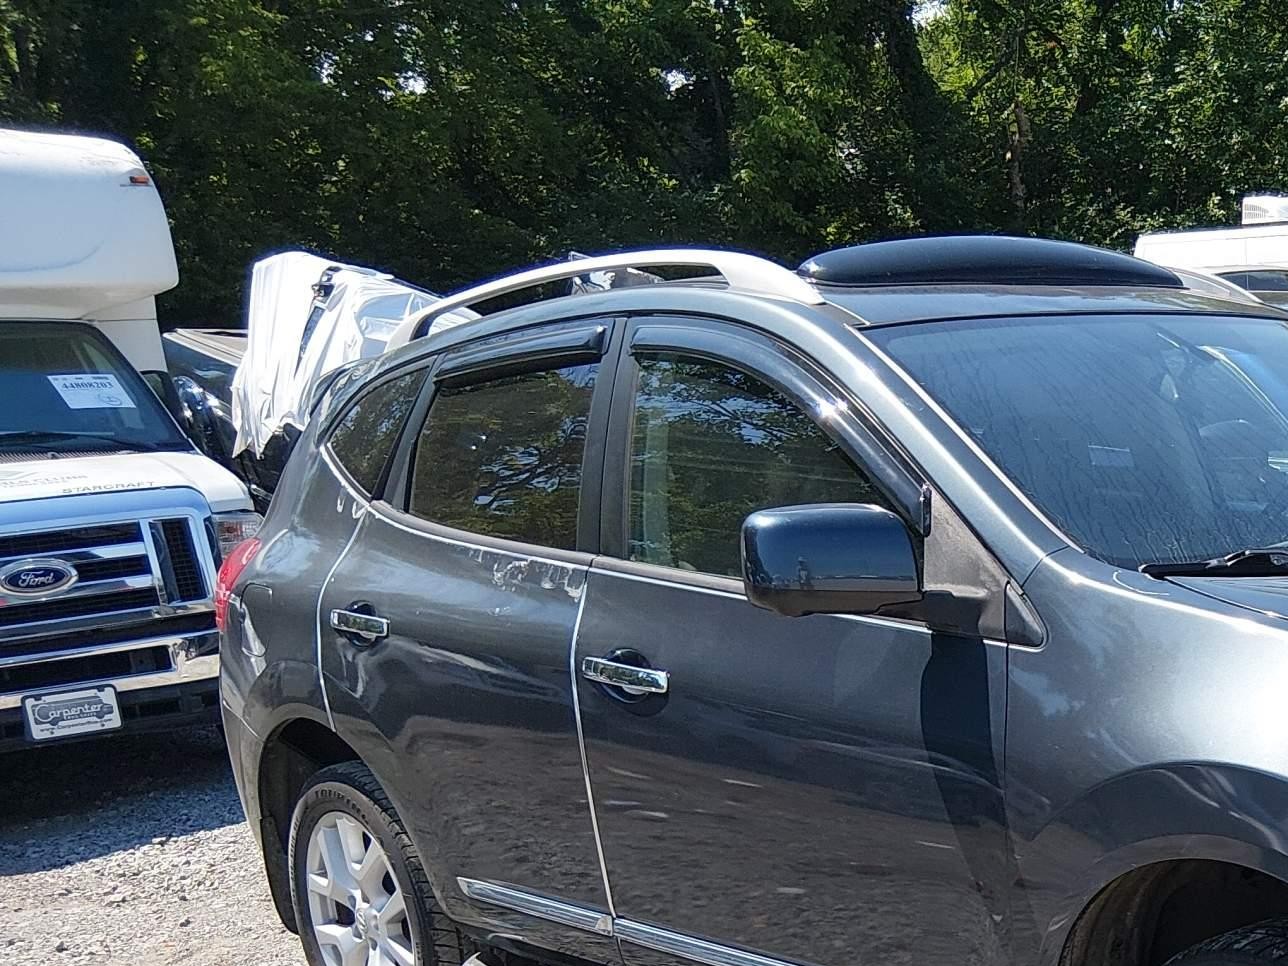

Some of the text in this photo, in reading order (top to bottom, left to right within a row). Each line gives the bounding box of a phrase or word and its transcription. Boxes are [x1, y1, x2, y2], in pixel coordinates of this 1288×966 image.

[62, 481, 155, 494] STARCRAFT
[18, 570, 56, 588] Ford
[34, 703, 105, 723] Carpenter
